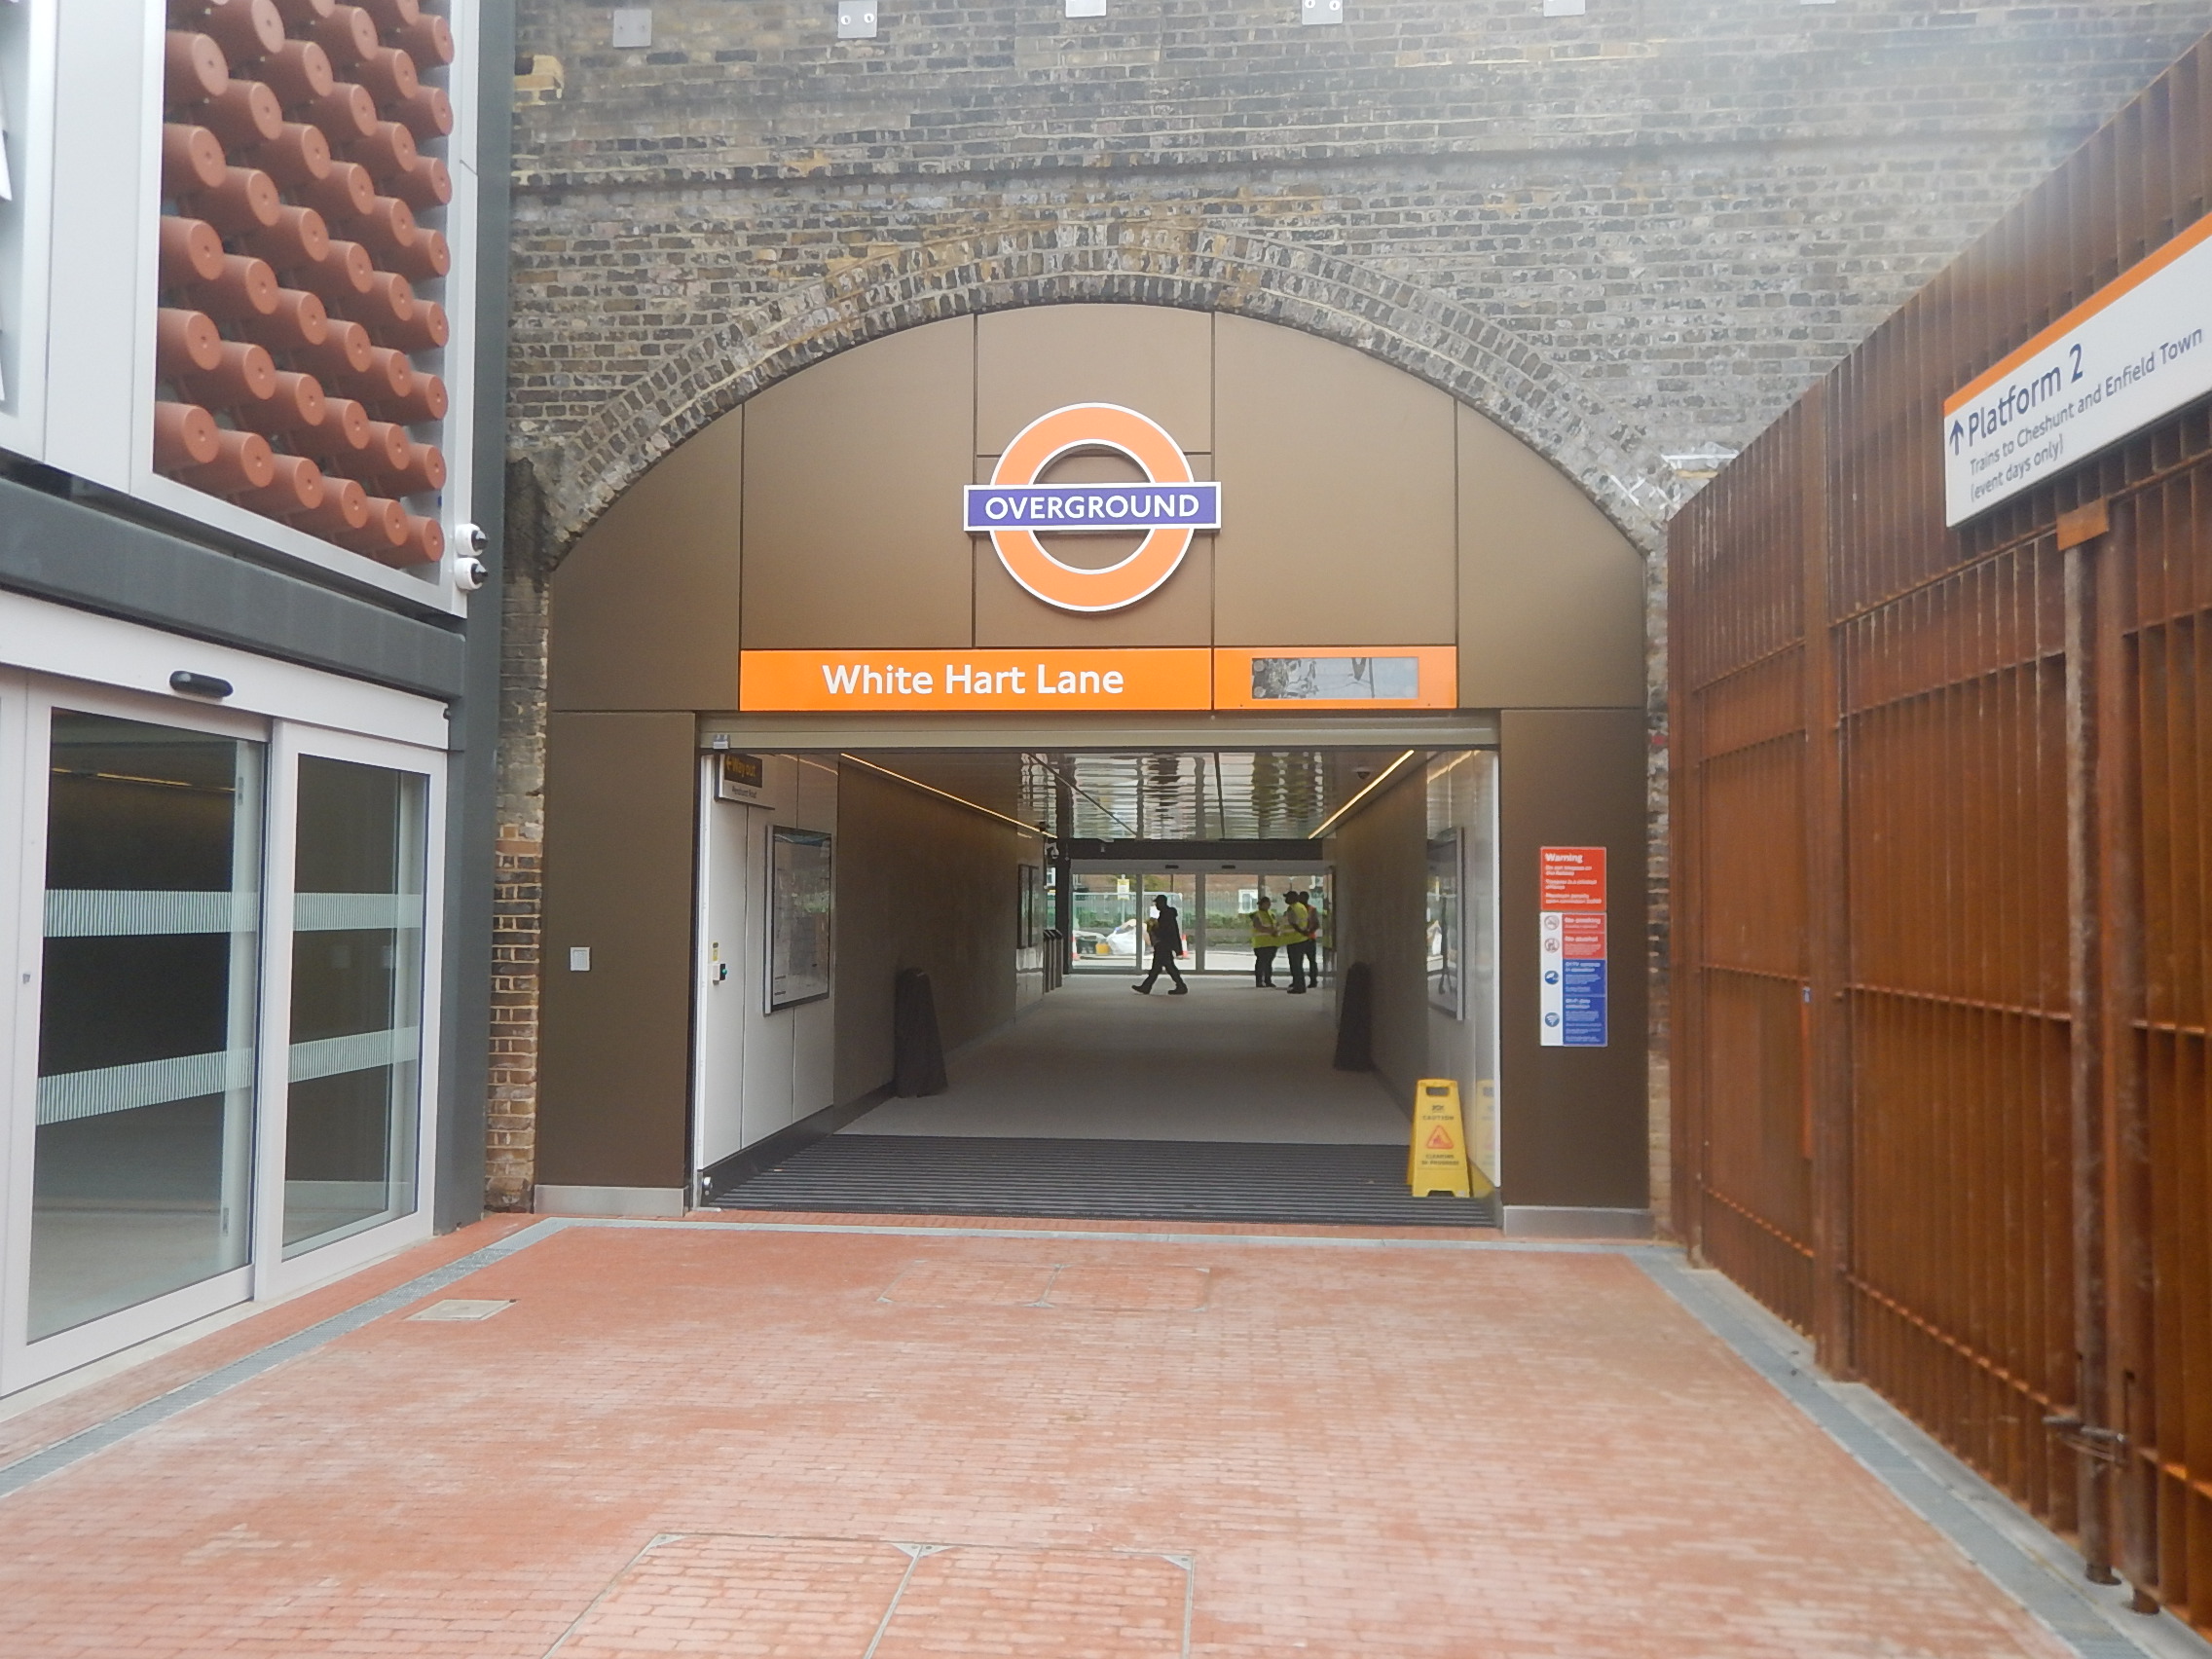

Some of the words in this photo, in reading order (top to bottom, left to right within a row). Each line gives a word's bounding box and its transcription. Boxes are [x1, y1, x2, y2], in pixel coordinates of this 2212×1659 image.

[1968, 366, 2062, 447] Platform
[2069, 343, 2084, 384] 2
[1970, 448, 2001, 476] Trains
[2003, 441, 2014, 459] to
[2016, 403, 2075, 448] Cheshunt
[2078, 384, 2102, 414] and
[2106, 351, 2156, 397] Enfield
[2159, 328, 2203, 365] Town
[1970, 468, 2004, 503] (event
[2006, 460, 2031, 484] days
[2033, 433, 2064, 466] only)
[984, 494, 1199, 520] OVERGROUND
[822, 663, 934, 694] White
[945, 663, 1026, 694] Hart
[1037, 663, 1124, 694] Lane
[1545, 853, 1583, 864] Warning
